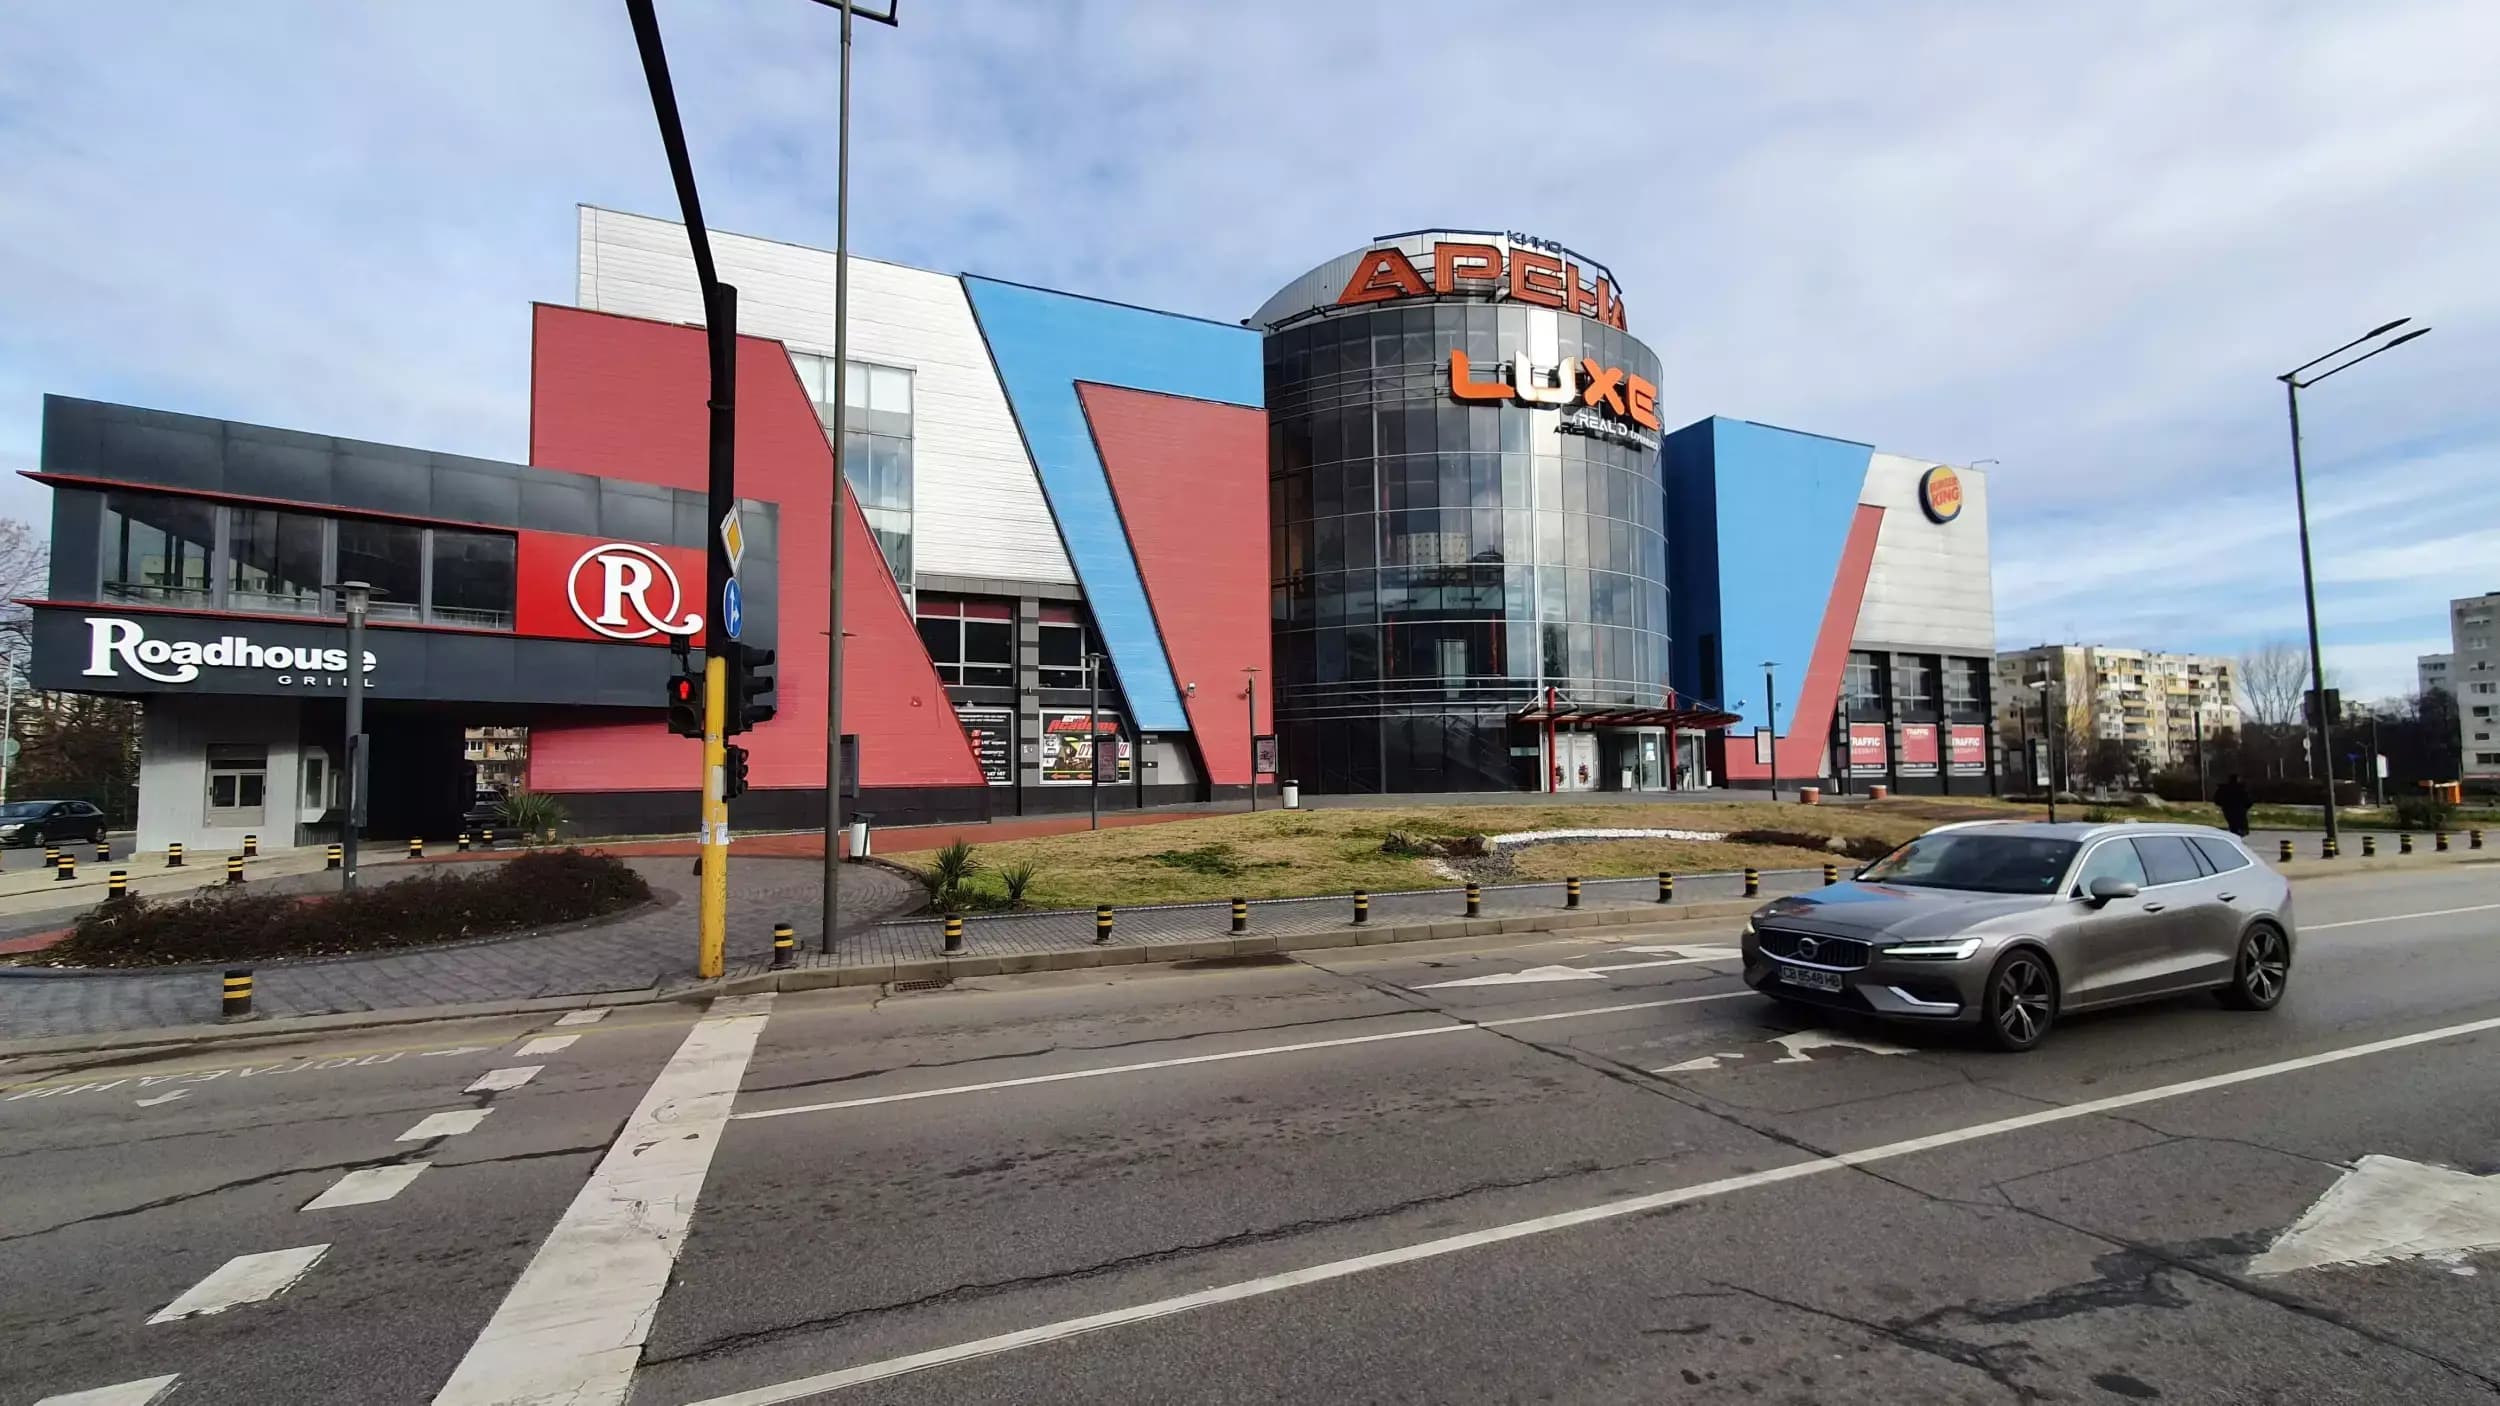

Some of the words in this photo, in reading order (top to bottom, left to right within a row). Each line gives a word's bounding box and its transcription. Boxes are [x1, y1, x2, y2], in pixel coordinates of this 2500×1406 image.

[1507, 229, 1563, 254] КИНО
[1337, 241, 1628, 332] АРЕНА
[1451, 348, 1661, 432] LUXE
[1932, 487, 1960, 508] KING
